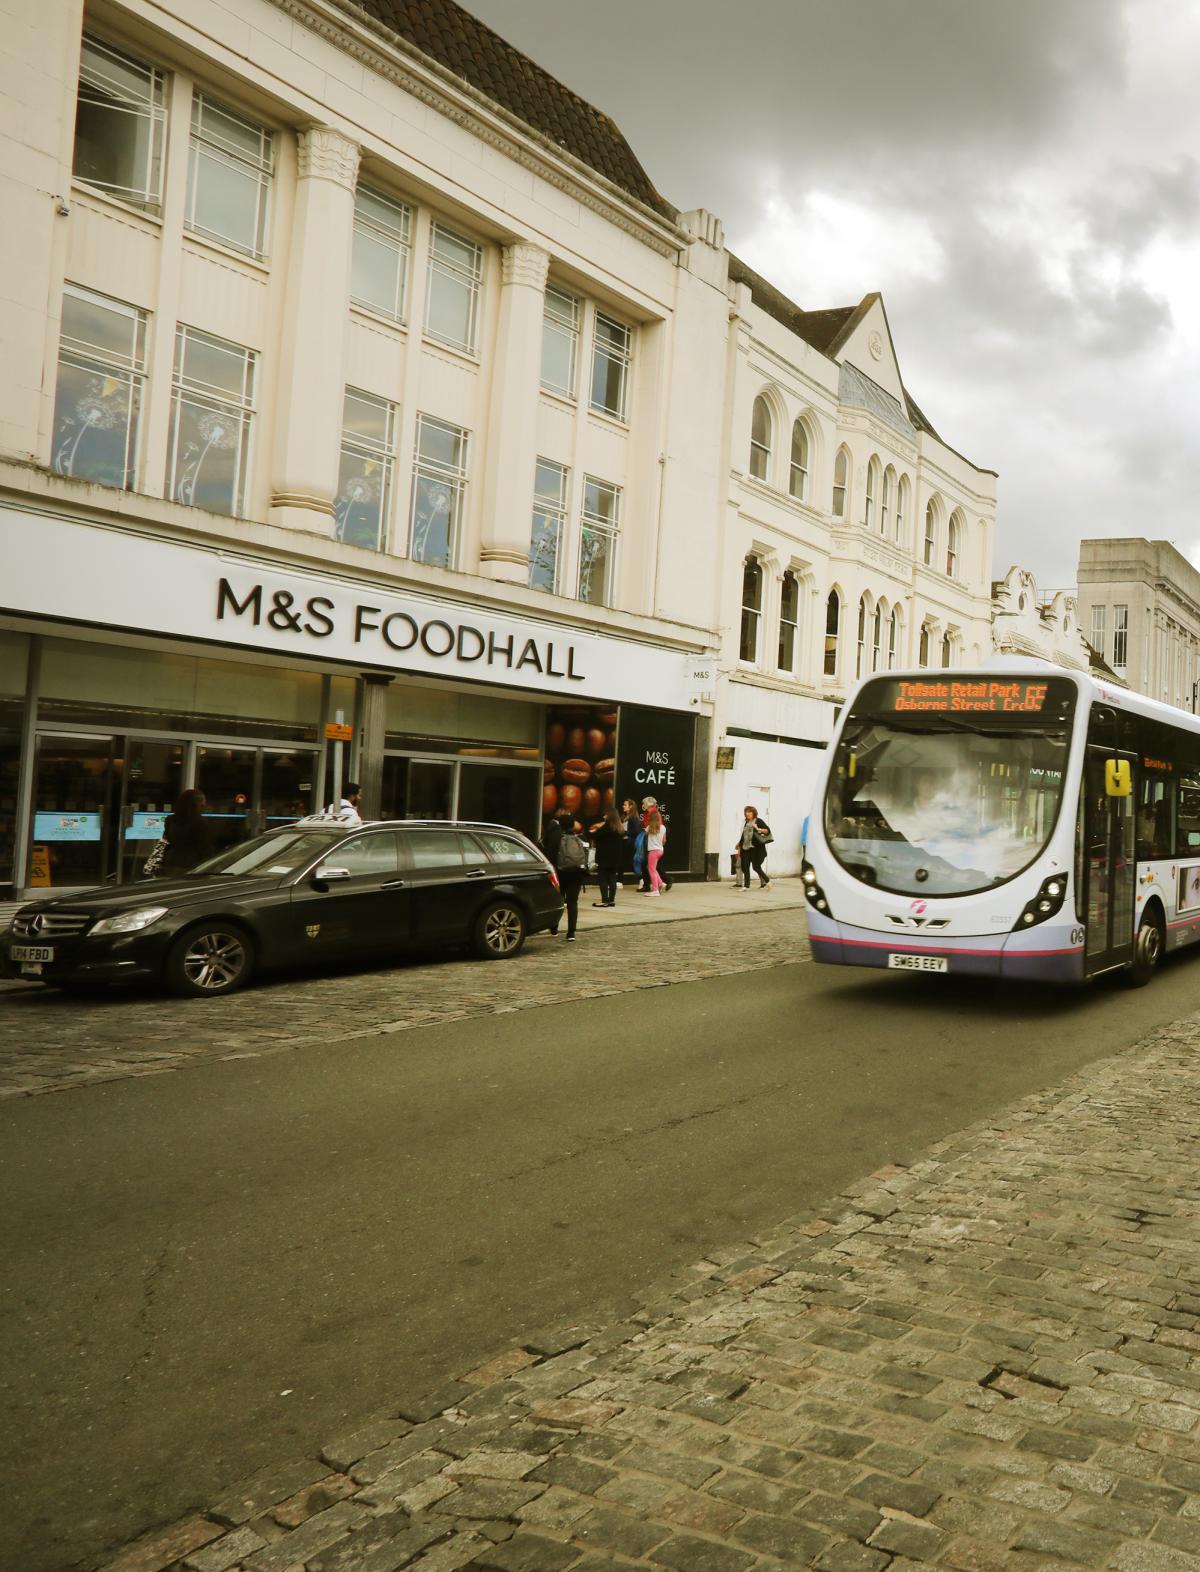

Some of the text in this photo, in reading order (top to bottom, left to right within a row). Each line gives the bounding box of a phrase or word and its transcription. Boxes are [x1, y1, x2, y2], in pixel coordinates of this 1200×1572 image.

[216, 577, 586, 681] M&S FOODHALL
[693, 671, 710, 679] M&S
[951, 682, 988, 697] Retail
[989, 682, 1020, 698] Park
[895, 697, 947, 711] Osborne
[951, 697, 996, 711] Street
[646, 750, 669, 765] M&S
[634, 766, 676, 785] CAFÉ
[923, 958, 944, 970] EEV
